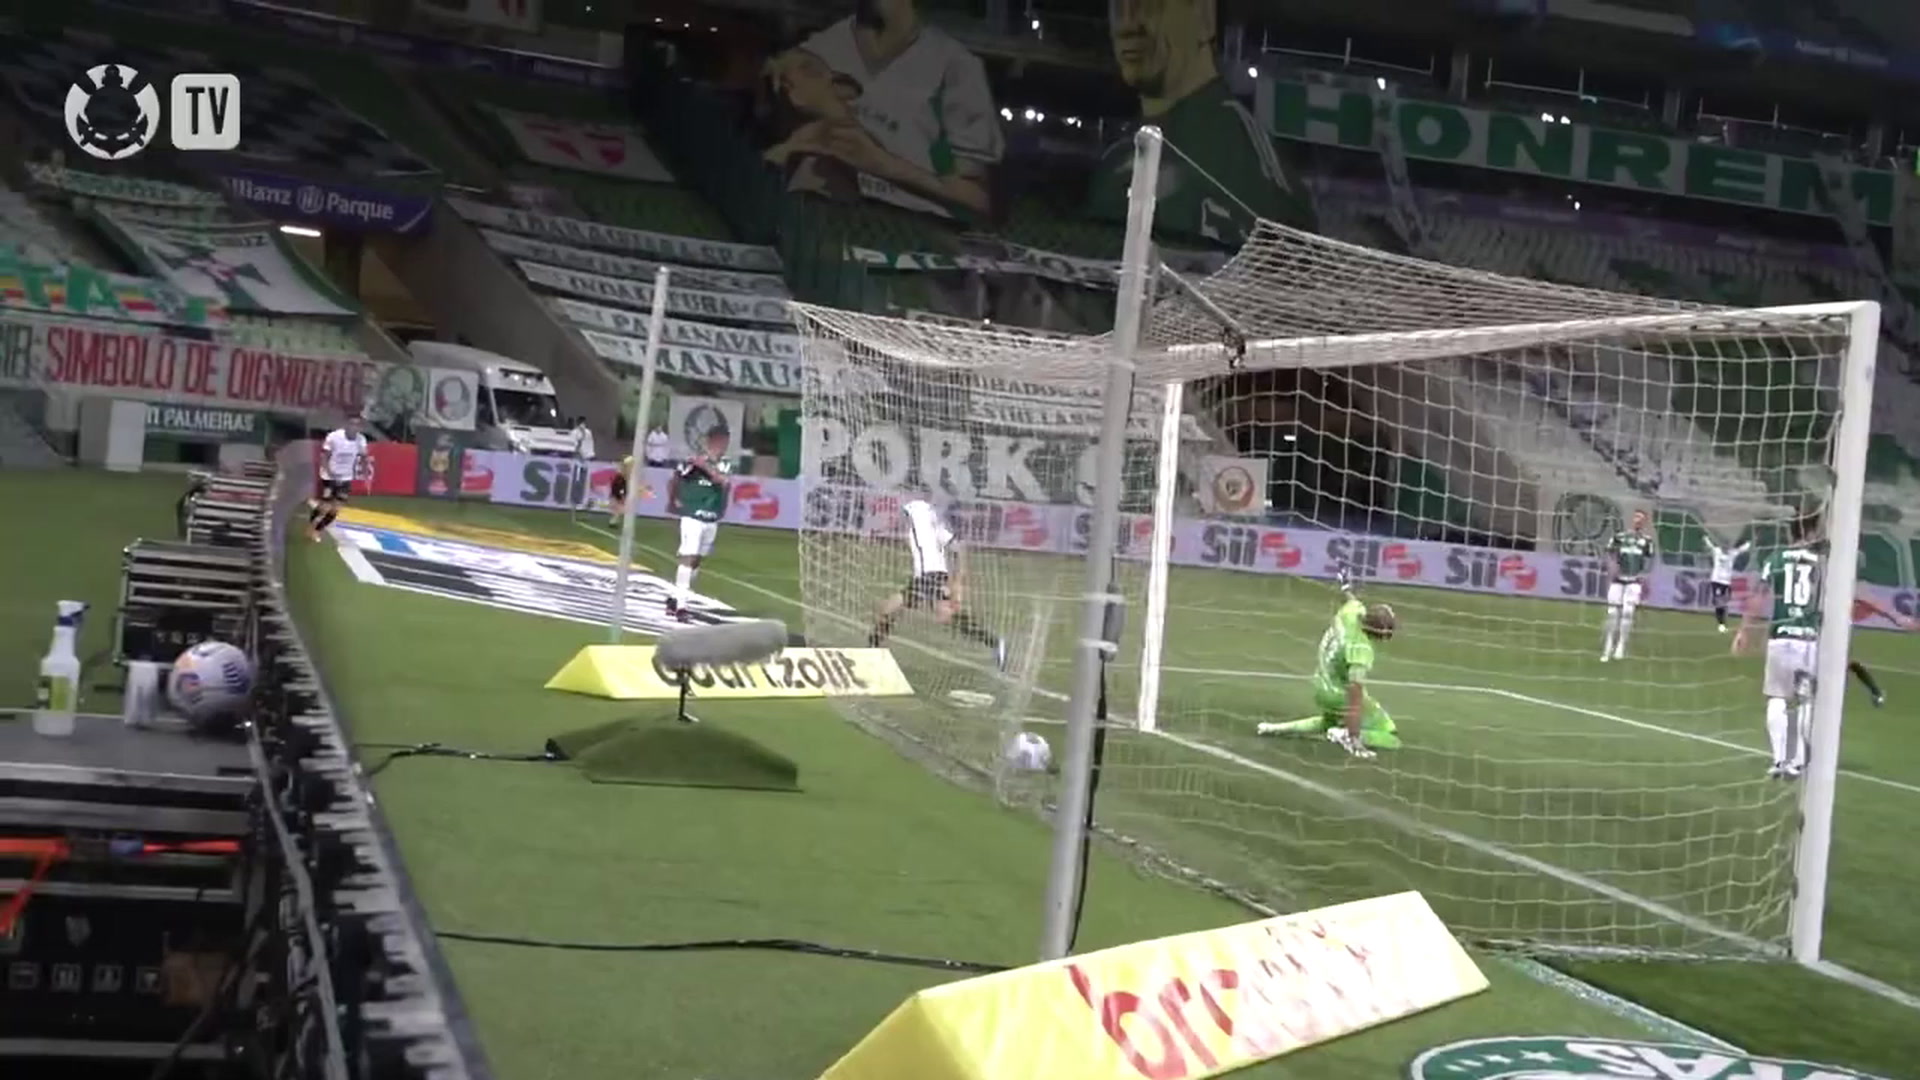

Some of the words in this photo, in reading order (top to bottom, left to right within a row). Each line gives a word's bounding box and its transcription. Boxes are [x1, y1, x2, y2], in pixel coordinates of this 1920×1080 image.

[231, 177, 293, 206] llianz
[326, 192, 395, 222] Parque
[184, 342, 220, 395] DE
[164, 407, 255, 432] PALMEIRAS
[803, 416, 1048, 502] PORK
[520, 460, 587, 504] Sil
[1201, 523, 1259, 567] Sil
[1445, 546, 1499, 588] Sil
[1783, 563, 1813, 606] 13
